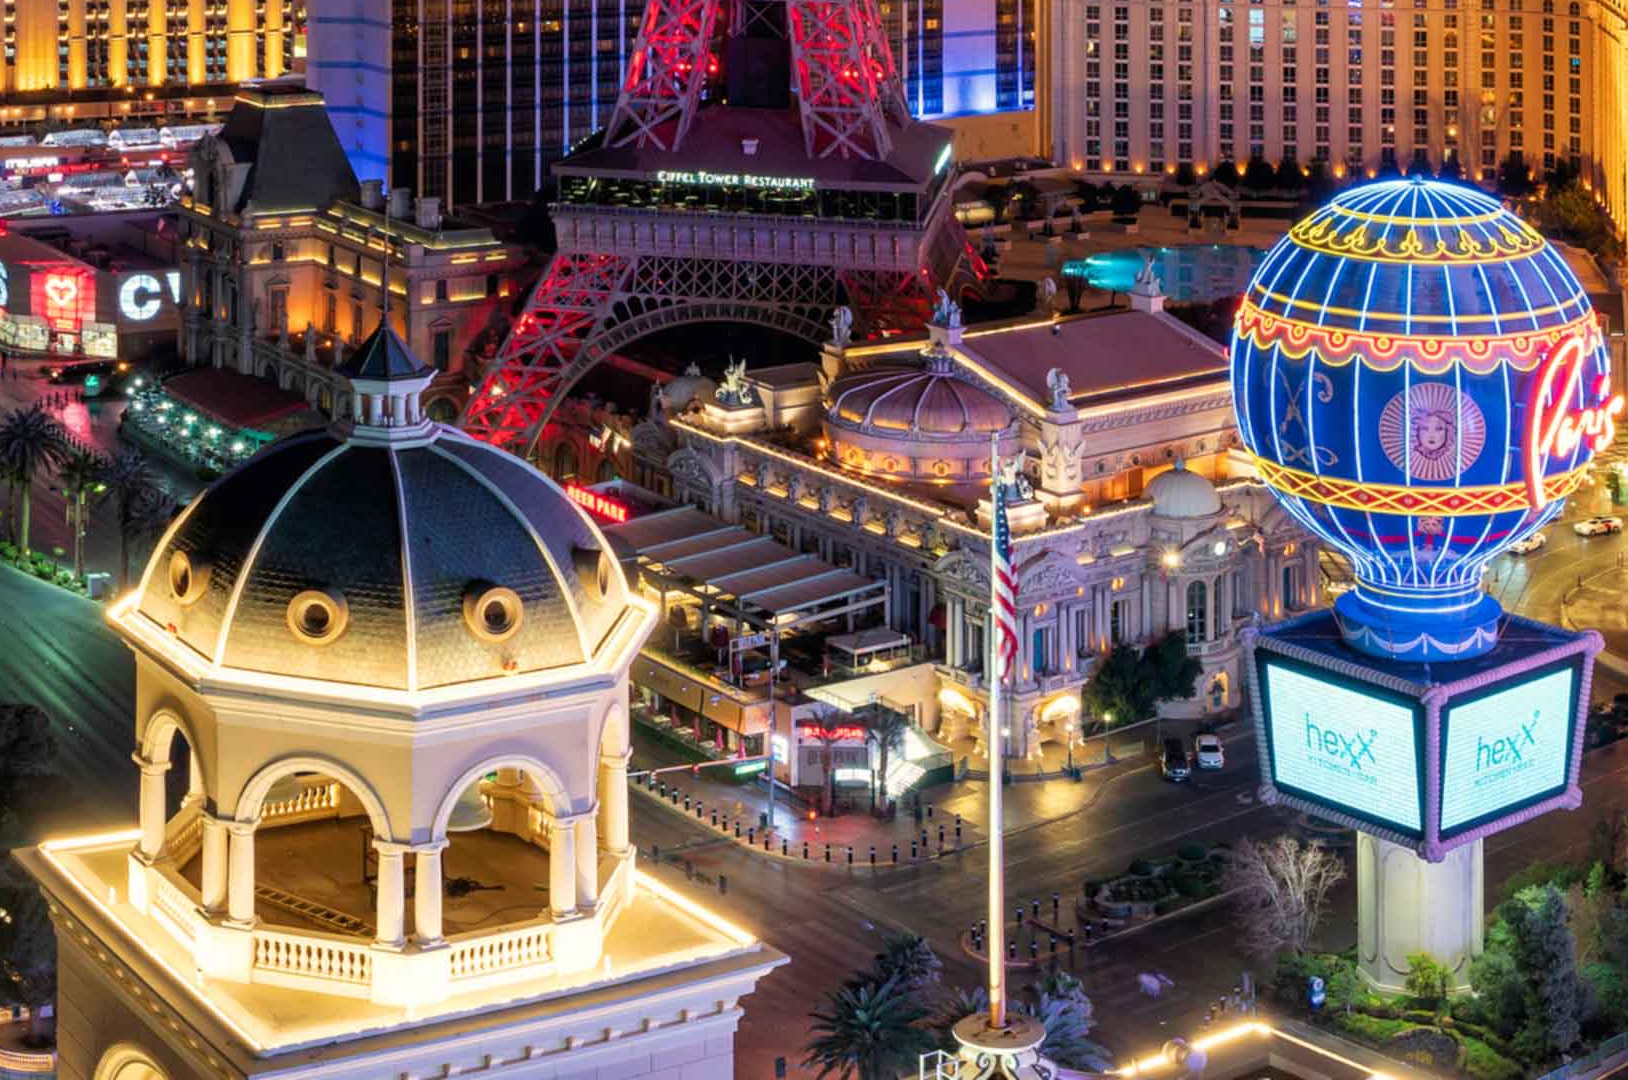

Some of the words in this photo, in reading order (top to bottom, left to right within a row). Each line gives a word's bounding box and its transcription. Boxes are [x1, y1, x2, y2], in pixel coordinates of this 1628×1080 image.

[657, 171, 695, 183] EIFFEL
[699, 172, 739, 185] TOWER
[744, 174, 815, 189] RESTAURANT
[1528, 335, 1625, 511] Paris
[596, 497, 626, 522] PARK
